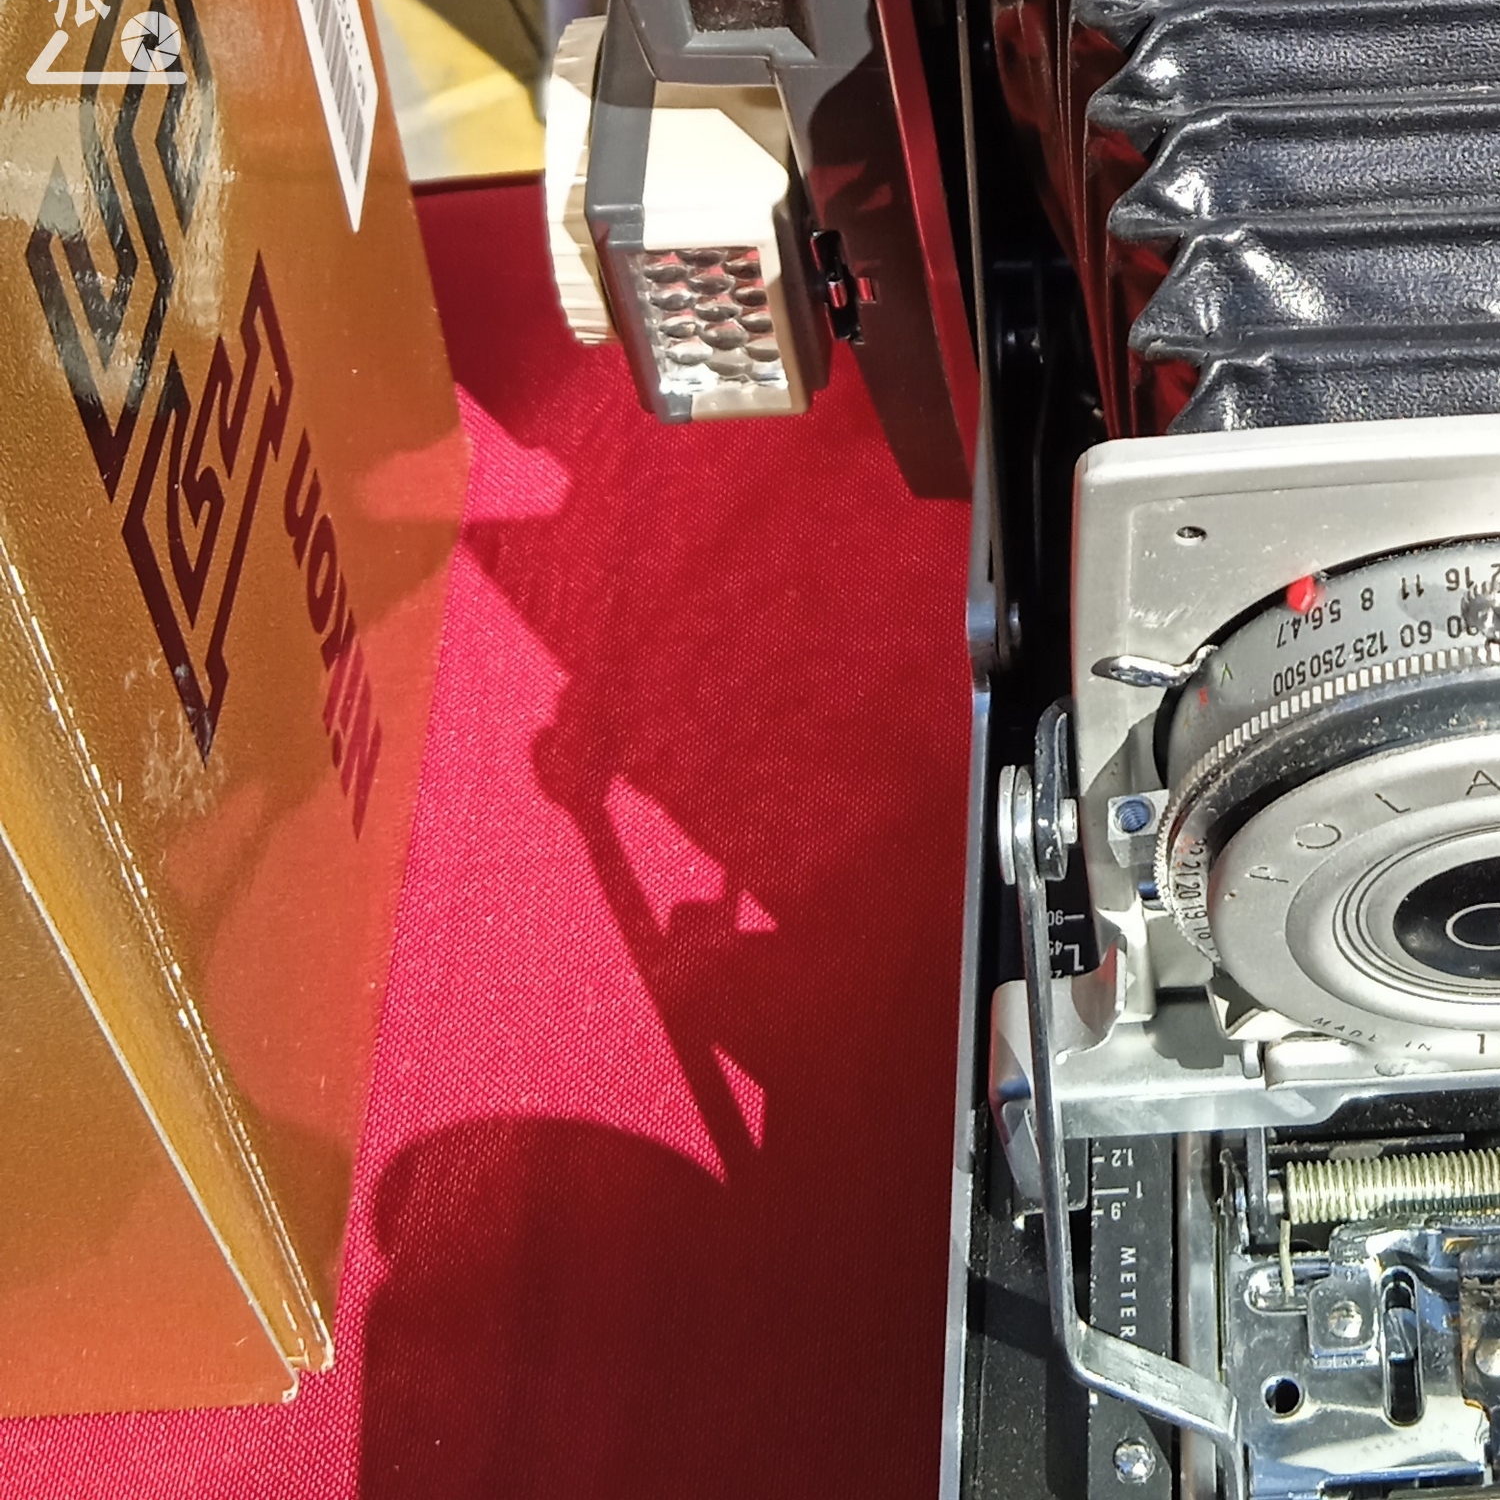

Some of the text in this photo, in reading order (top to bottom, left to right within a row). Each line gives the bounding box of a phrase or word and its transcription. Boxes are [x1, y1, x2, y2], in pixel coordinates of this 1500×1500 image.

[1401, 573, 1425, 600] 11
[1445, 566, 1474, 592] 16
[1360, 587, 1374, 611] 8
[1311, 598, 1342, 630] 5.6
[282, 427, 383, 841] Nikon
[1275, 616, 1302, 649] 4.7
[1400, 619, 1433, 648] 60
[1311, 642, 1347, 678] 250
[1353, 630, 1389, 663] 125
[1273, 667, 1306, 697] 500
[1176, 883, 1201, 900] 20
[1047, 909, 1064, 926] 90
[1181, 904, 1208, 920] 19
[1111, 1148, 1134, 1168] 1.2
[1135, 1180, 1143, 1199] 1
[1110, 1201, 1127, 1221] .9
[1120, 1246, 1137, 1339] METER
